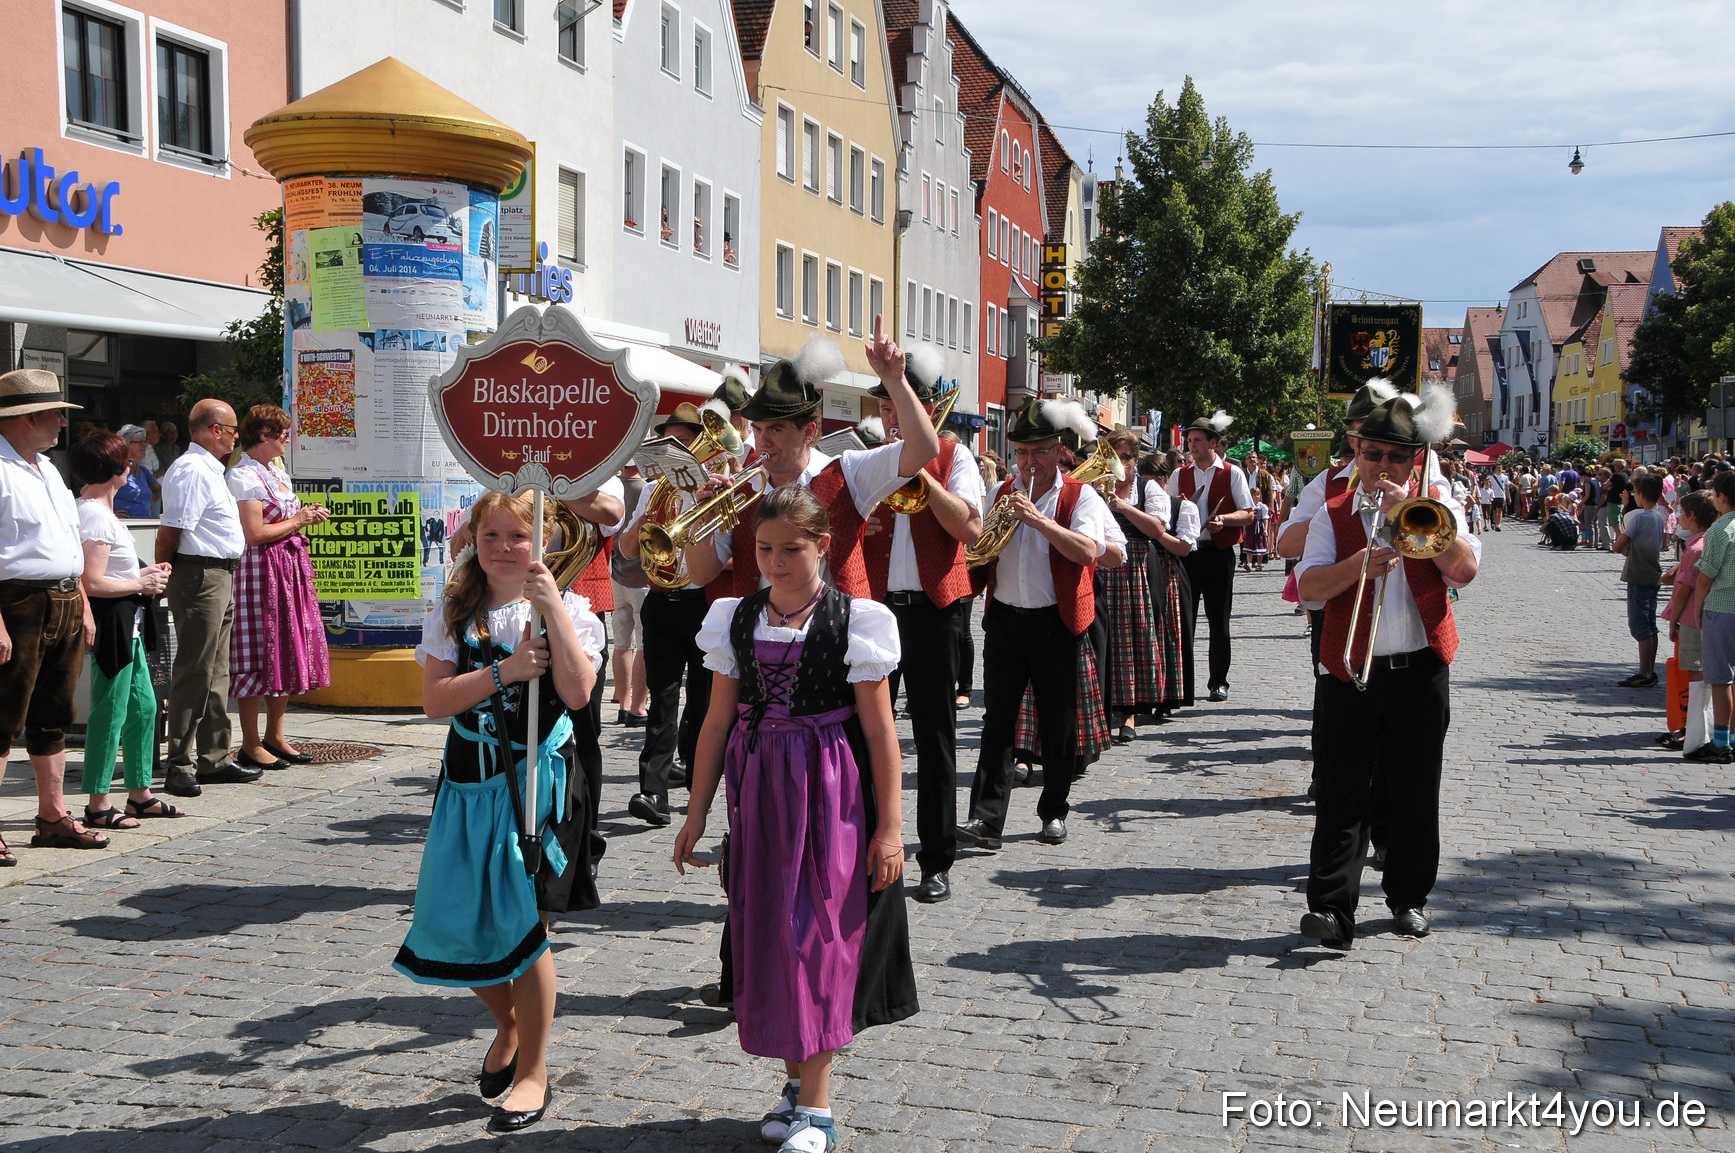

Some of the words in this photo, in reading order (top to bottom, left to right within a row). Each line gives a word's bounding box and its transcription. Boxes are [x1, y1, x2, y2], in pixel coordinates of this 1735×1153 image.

[369, 264, 381, 272] 04.
[383, 264, 397, 272] Juli
[400, 265, 417, 273] 2014
[687, 318, 722, 347] Weltbild
[473, 378, 610, 410] Blaskapelle
[483, 412, 598, 439] Dirnhofer
[522, 445, 552, 463] Stauf
[377, 499, 414, 516] Cub
[322, 560, 356, 569] SAMSTAGS
[364, 560, 415, 569] Einlass
[338, 571, 356, 579] 14.08.
[364, 570, 382, 579] 24
[387, 570, 414, 579] UHR
